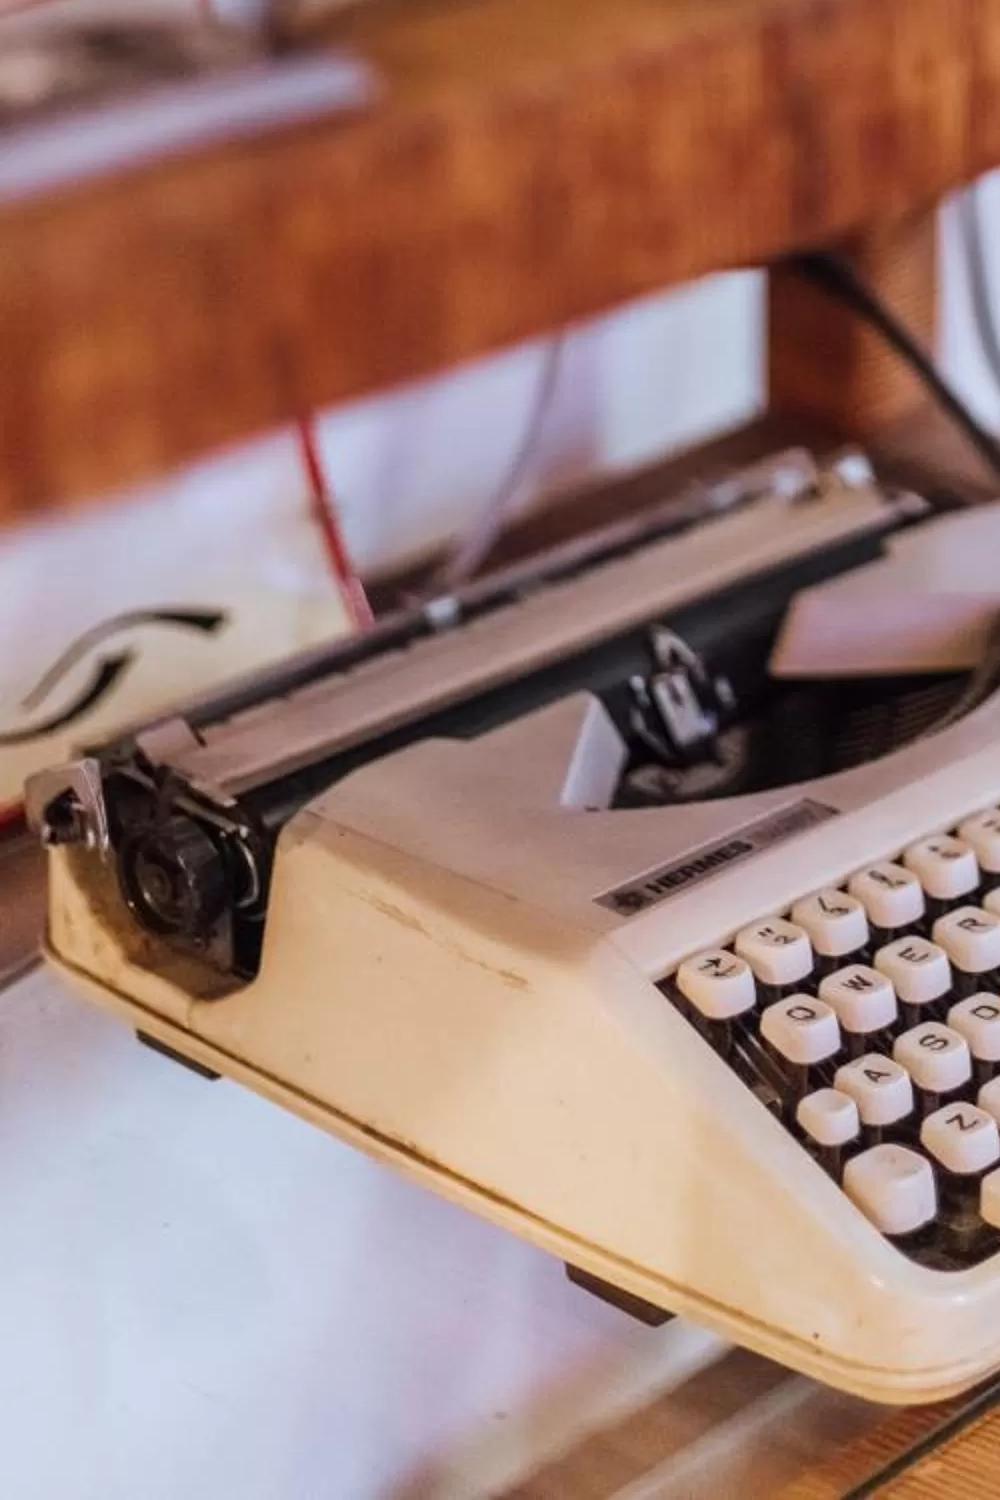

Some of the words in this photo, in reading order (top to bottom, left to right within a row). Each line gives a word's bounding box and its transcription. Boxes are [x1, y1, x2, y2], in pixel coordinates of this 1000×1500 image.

[645, 840, 753, 894] HERMES
[841, 974, 873, 991] W
[897, 946, 930, 962] E
[956, 917, 989, 931] R
[863, 1069, 892, 1084] A
[919, 1033, 949, 1051] S
[970, 1005, 1000, 1020] D
[945, 1112, 980, 1131] Z
